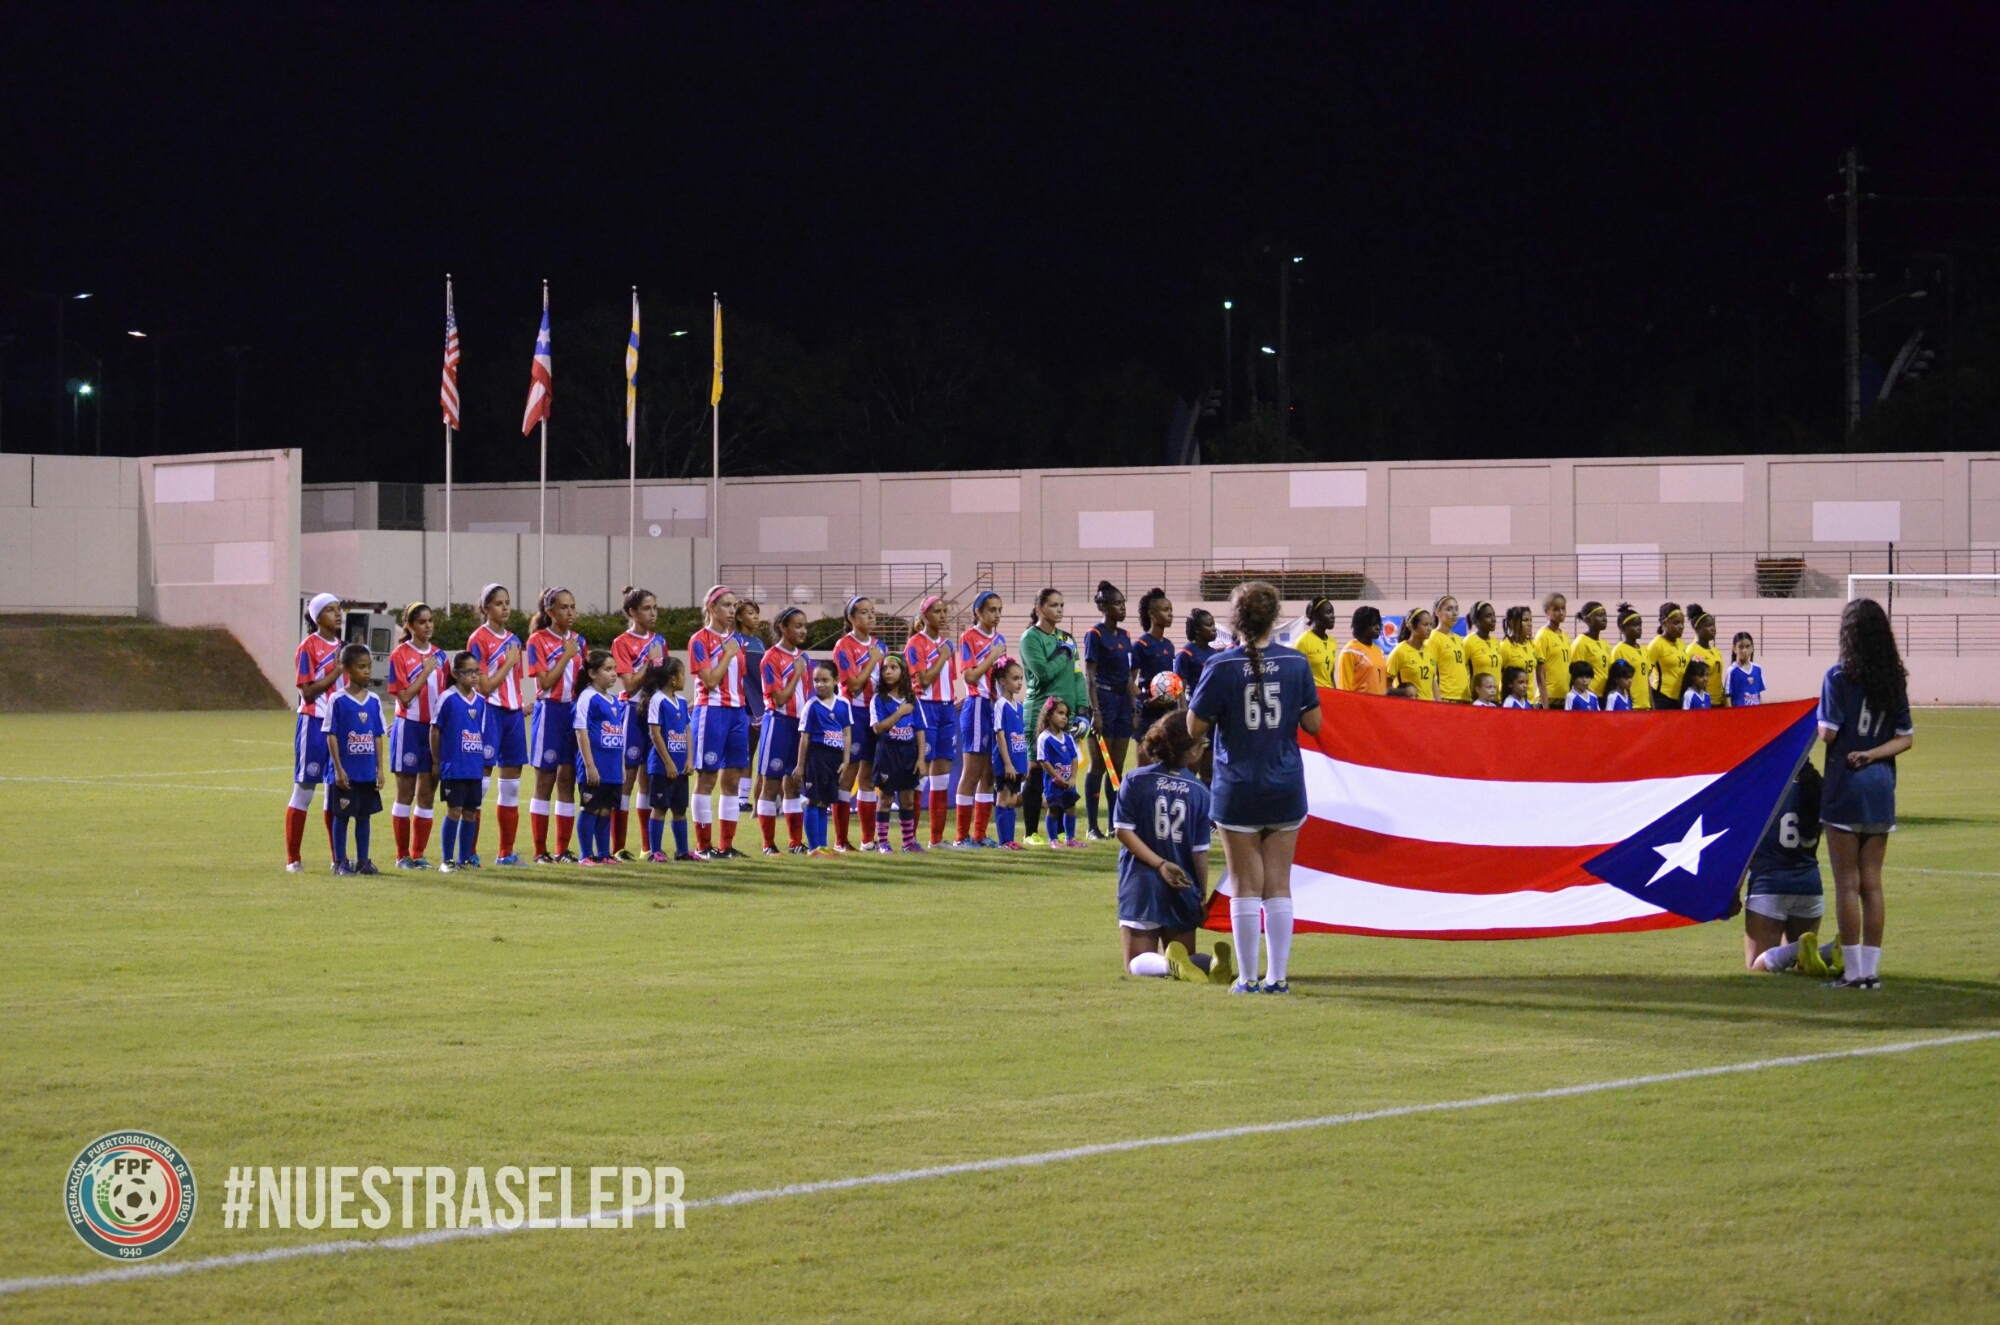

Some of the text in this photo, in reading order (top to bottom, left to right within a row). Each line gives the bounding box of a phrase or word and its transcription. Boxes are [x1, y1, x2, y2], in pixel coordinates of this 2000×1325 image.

[1453, 650, 1463, 664] 18
[1489, 654, 1499, 668] 17
[1419, 665, 1429, 680] 12
[1244, 682, 1282, 730] 65
[463, 742, 483, 752] GOY
[602, 736, 623, 747] GOY
[669, 742, 687, 751] GOY
[1154, 795, 1187, 843] 62
[1779, 812, 1817, 848] 6
